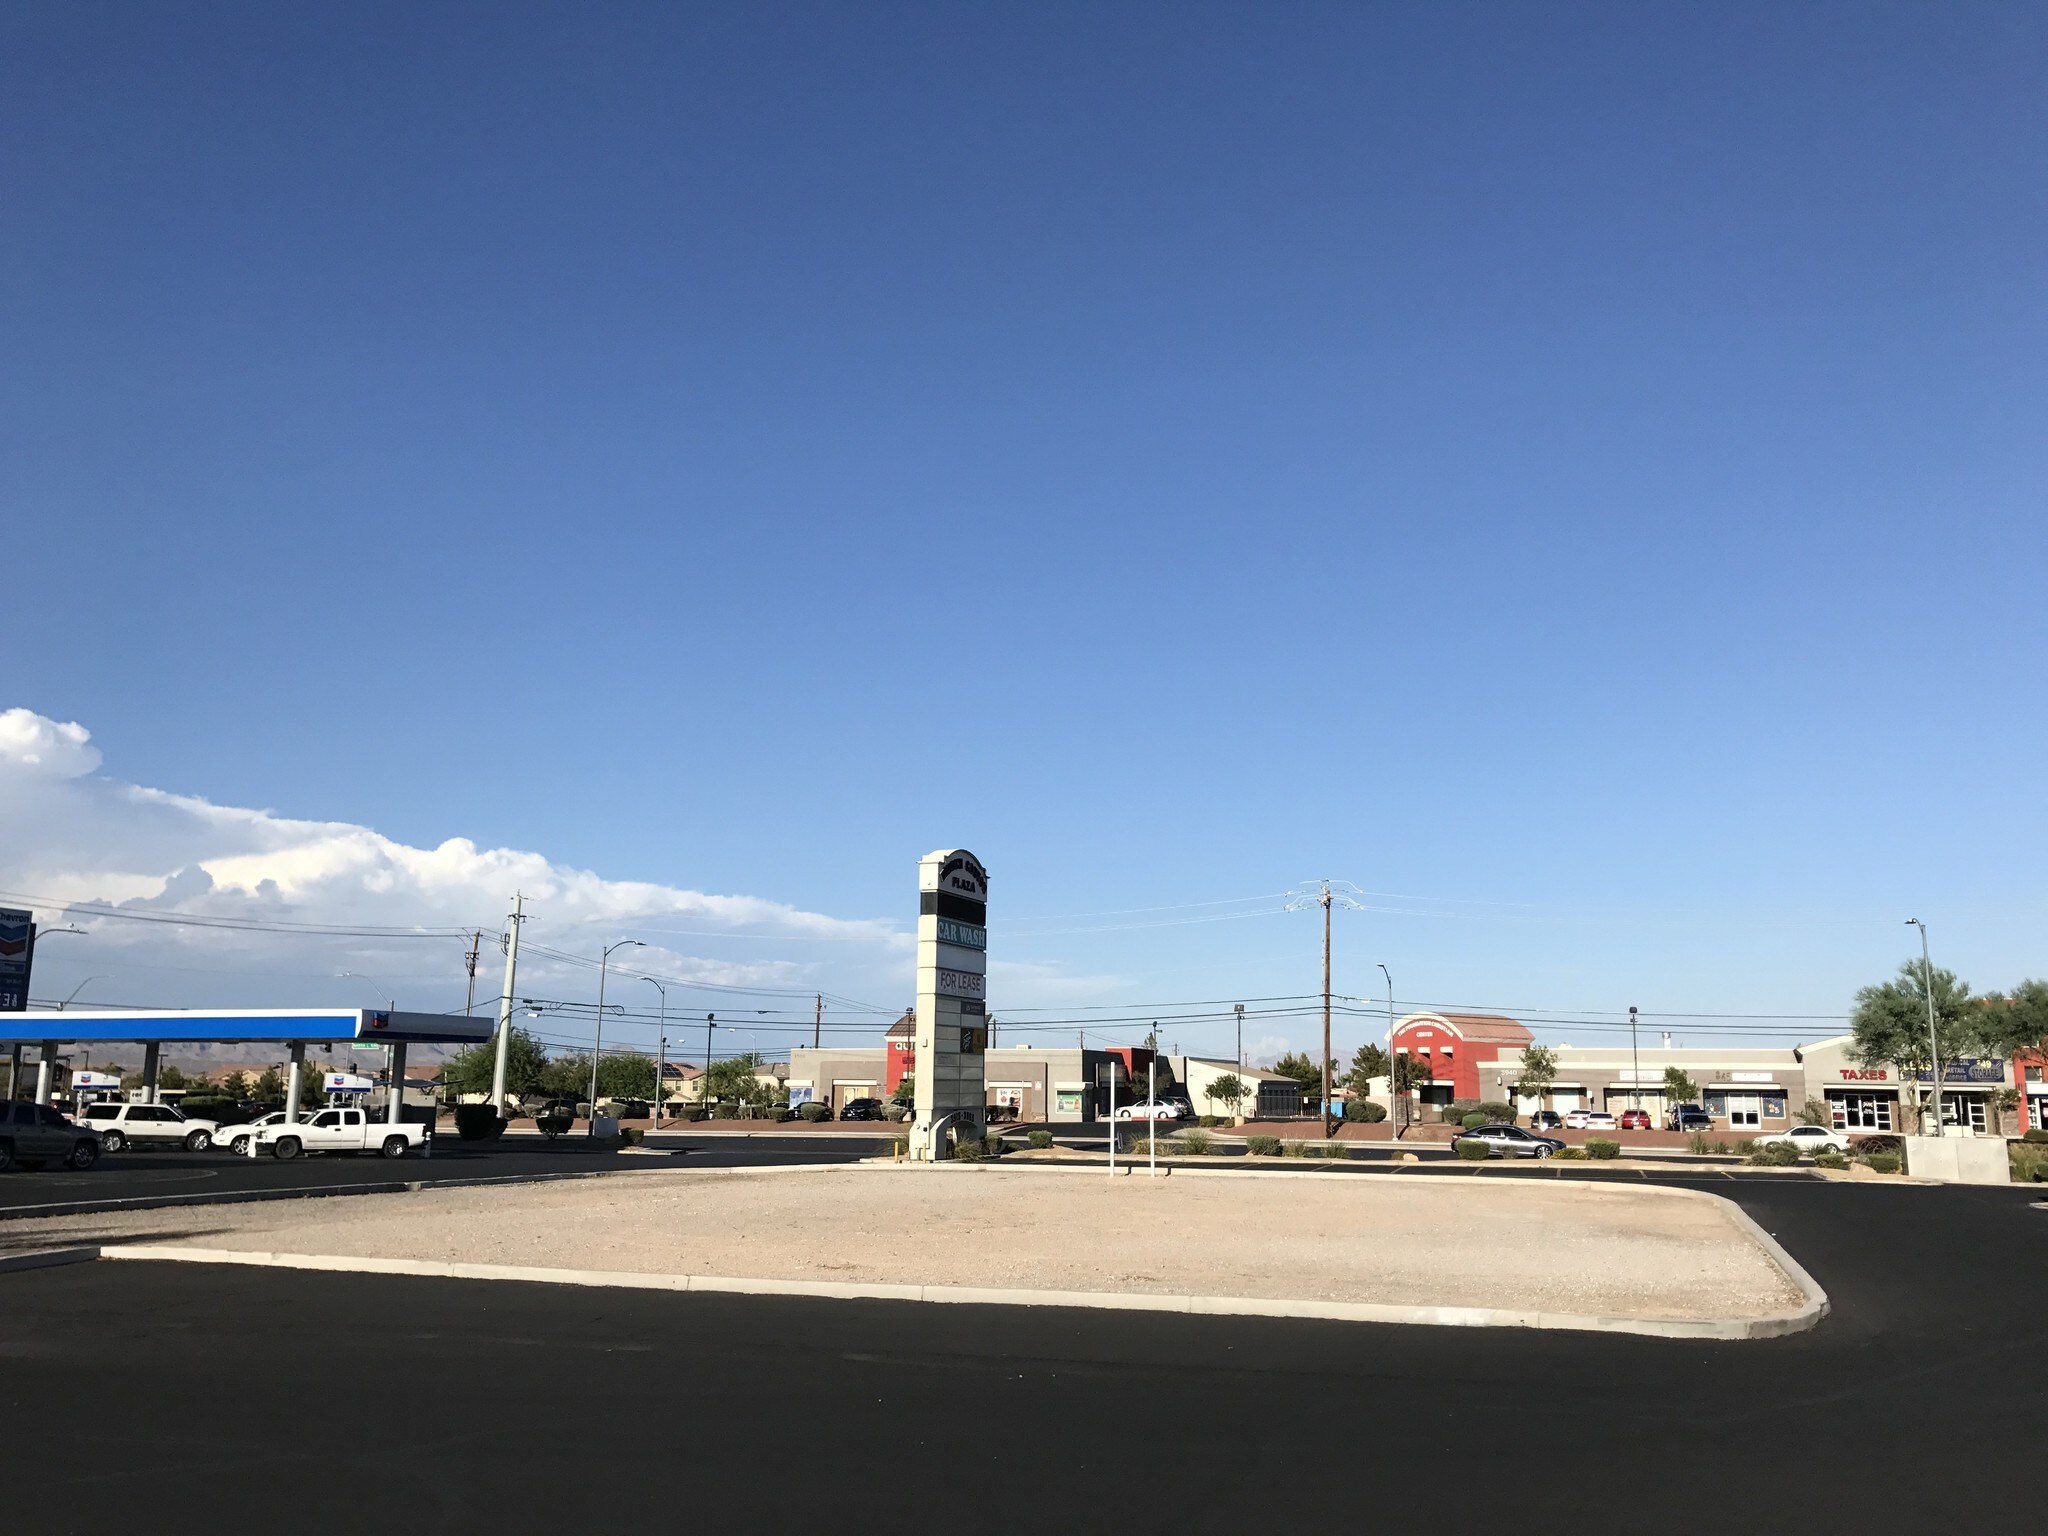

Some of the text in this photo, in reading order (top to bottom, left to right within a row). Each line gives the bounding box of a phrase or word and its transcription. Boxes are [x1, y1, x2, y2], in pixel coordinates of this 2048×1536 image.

[951, 876, 976, 893] PLAZA
[0, 912, 29, 923] hevron
[938, 921, 986, 947] CAR WASH
[940, 971, 981, 992] FOR LEASE
[1839, 1069, 1888, 1081] TAXES
[1971, 1067, 1999, 1079] STORAGE
